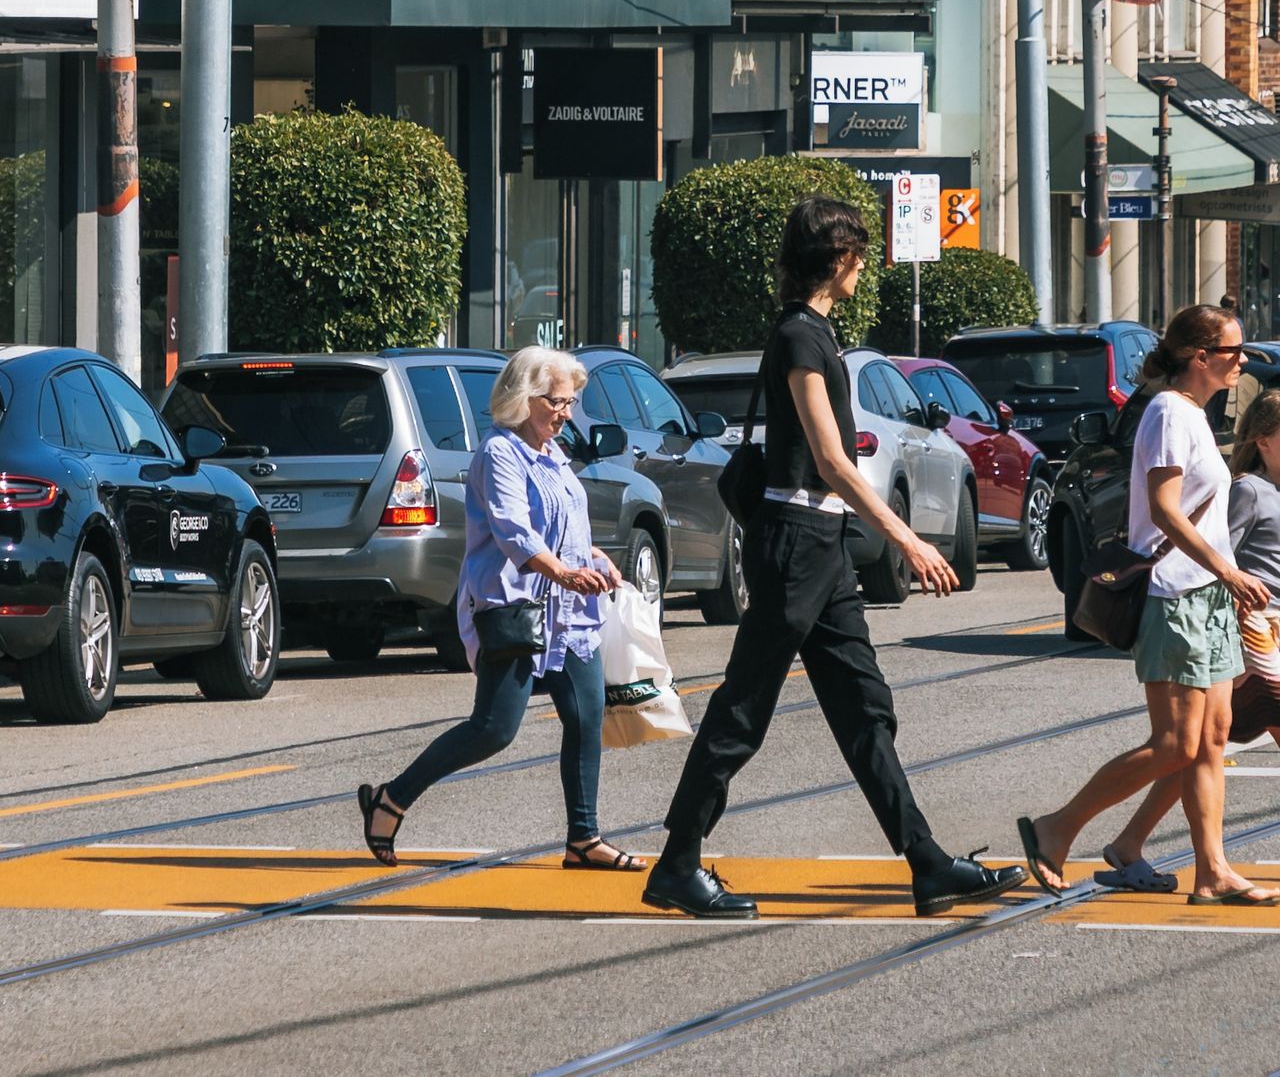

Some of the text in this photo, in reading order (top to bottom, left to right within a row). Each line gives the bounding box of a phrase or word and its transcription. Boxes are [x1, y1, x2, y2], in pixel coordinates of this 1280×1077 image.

[838, 111, 909, 138] jacadi
[899, 205, 912, 218] 1P
[1120, 202, 1143, 214] Bleu
[1200, 200, 1273, 215] optometrists
